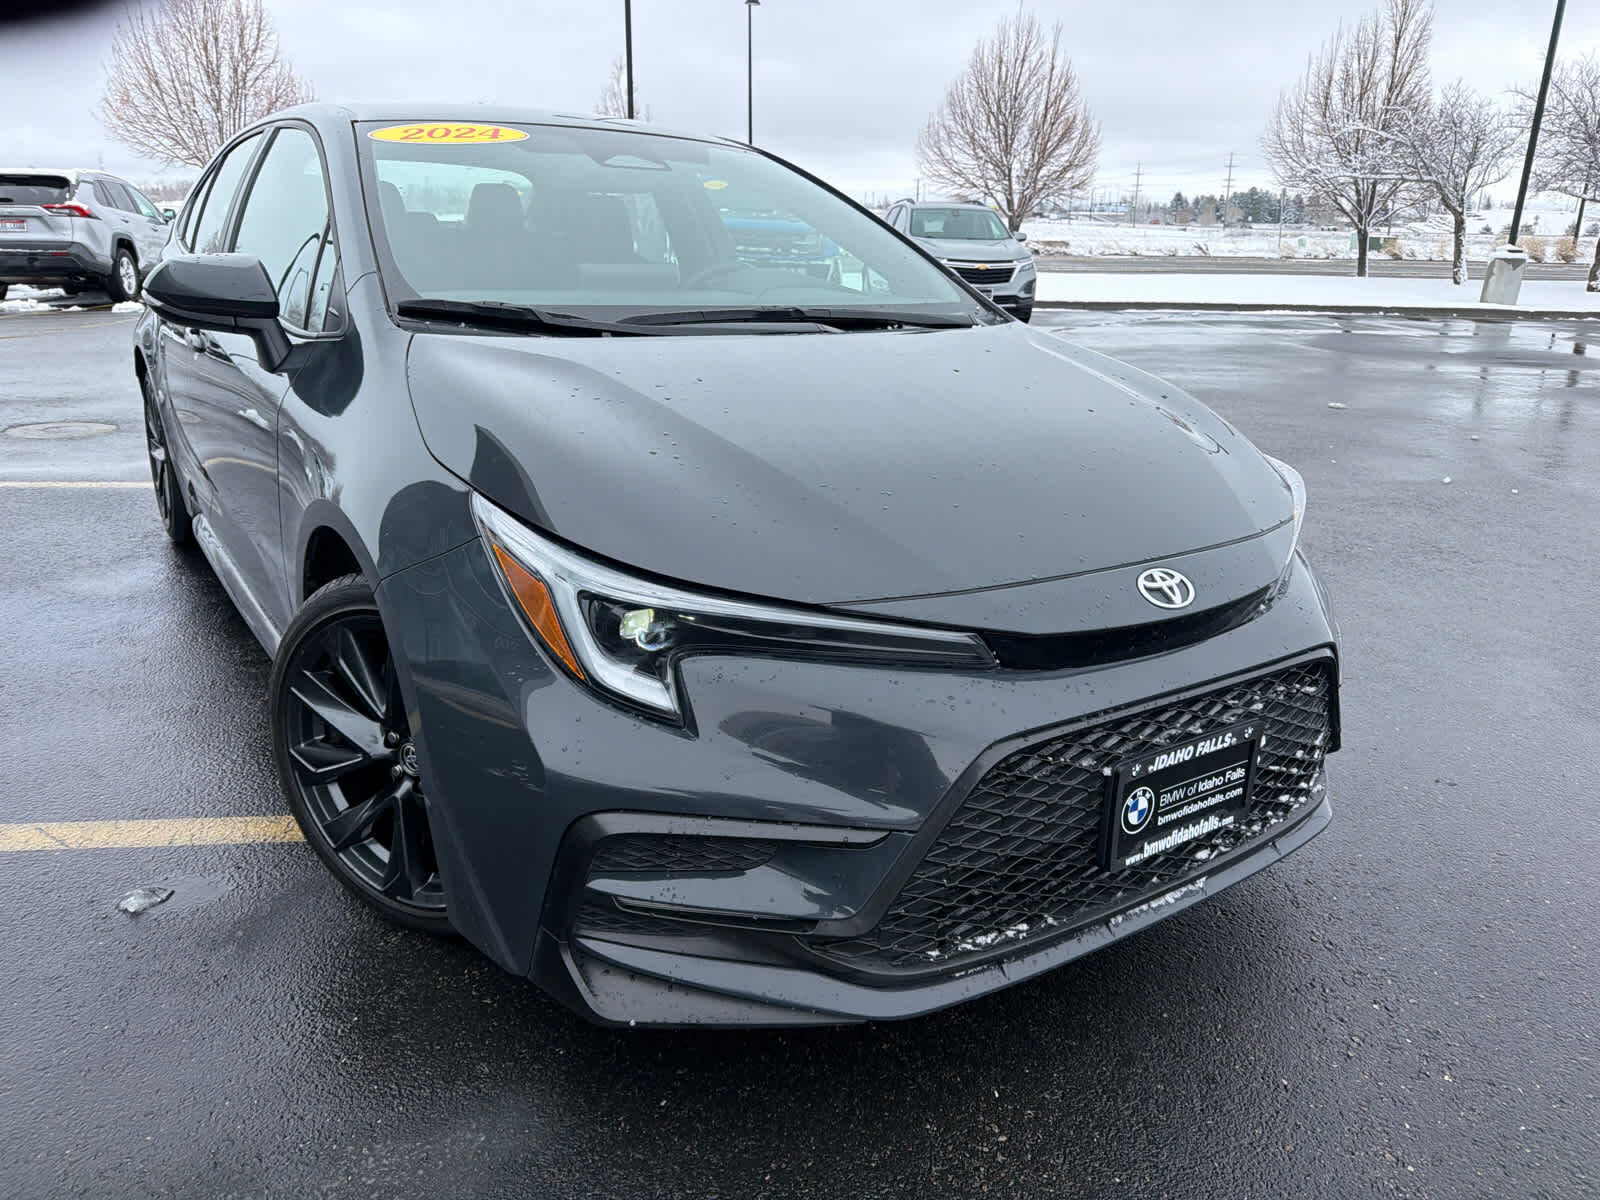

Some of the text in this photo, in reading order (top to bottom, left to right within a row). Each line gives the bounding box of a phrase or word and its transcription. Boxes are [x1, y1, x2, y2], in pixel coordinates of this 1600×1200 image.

[400, 127, 504, 140] 2024
[1153, 733, 1233, 771] IDAHO FALLS
[1157, 787, 1243, 826] bmwofidahofalls.com
[1160, 767, 1246, 807] BMW of Idaho Falls
[1125, 815, 1234, 866] www.bmwofidahofalls.com
